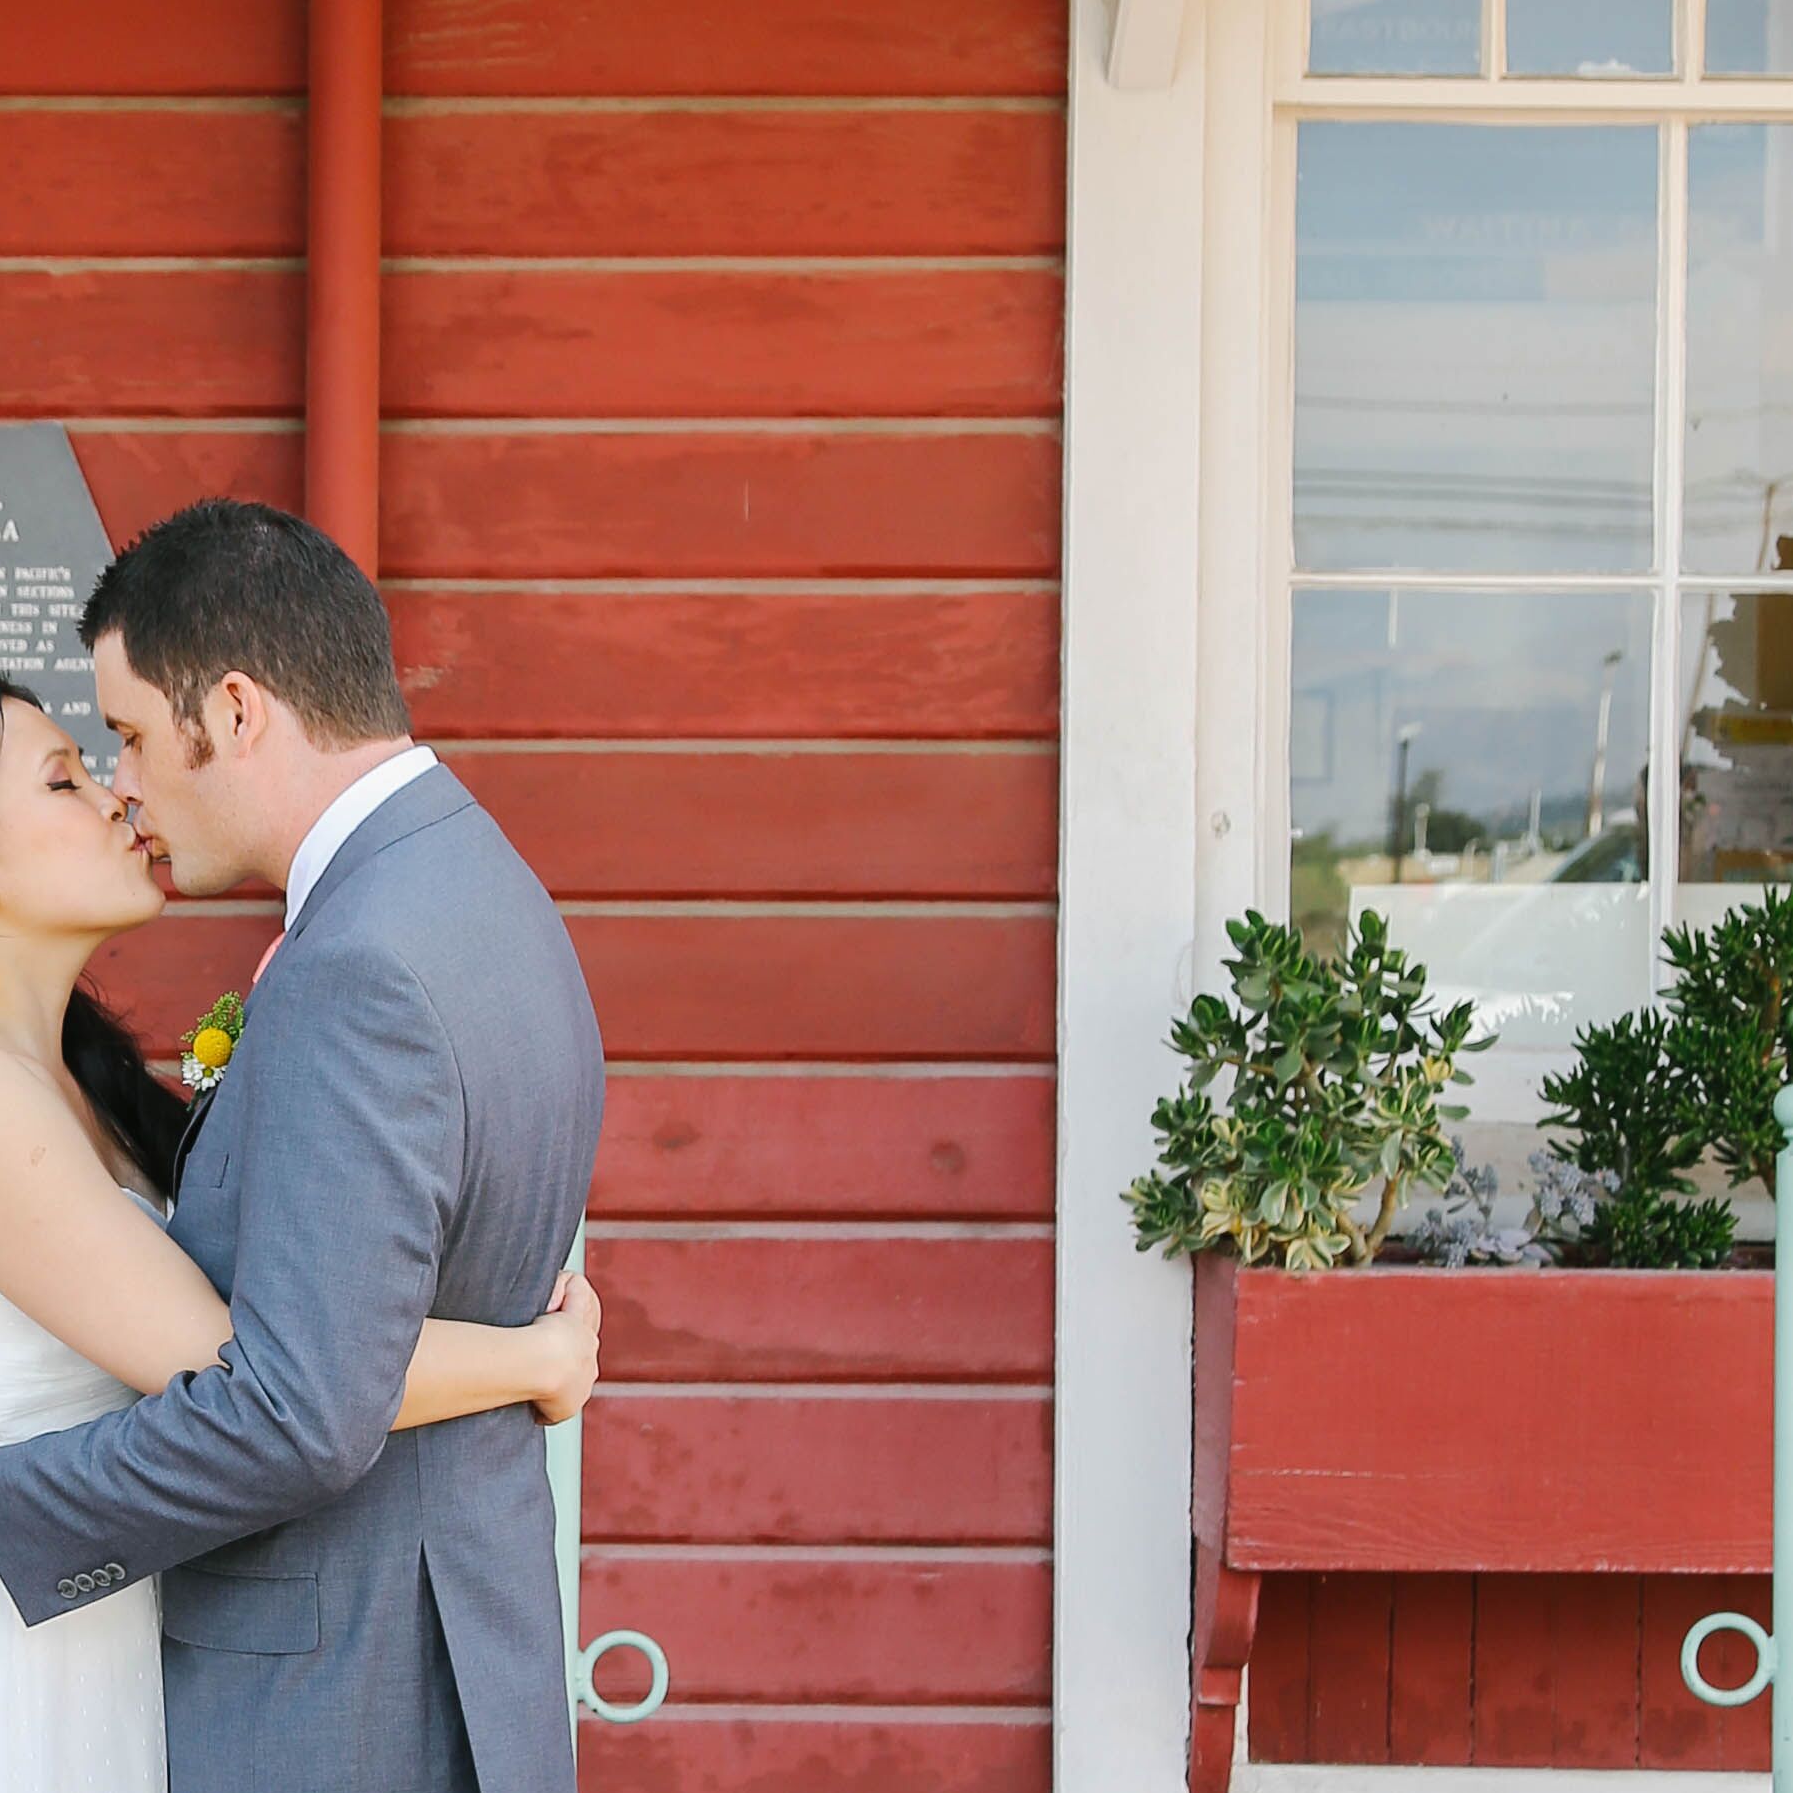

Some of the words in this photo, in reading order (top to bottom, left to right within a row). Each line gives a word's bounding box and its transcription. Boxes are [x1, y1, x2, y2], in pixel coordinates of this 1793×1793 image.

[10, 602, 40, 617] THIS
[41, 621, 58, 634] IN
[35, 639, 55, 653] AS
